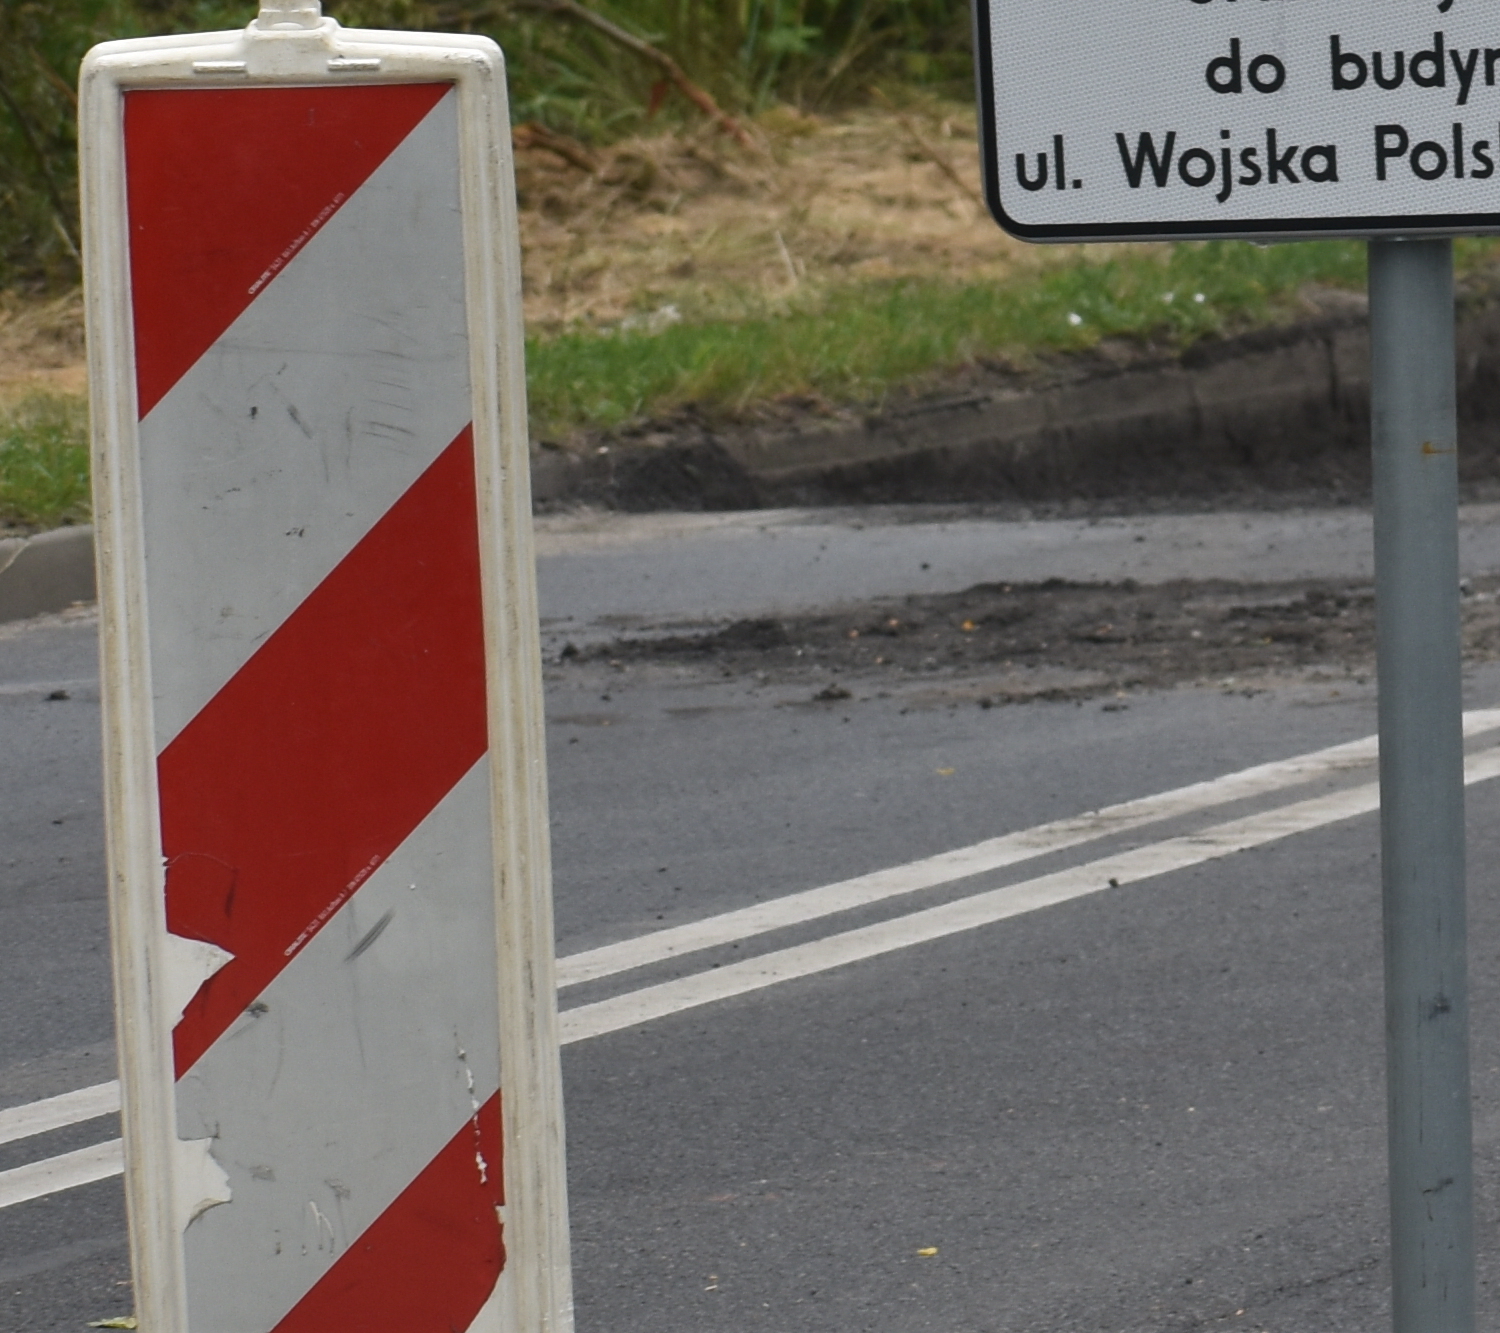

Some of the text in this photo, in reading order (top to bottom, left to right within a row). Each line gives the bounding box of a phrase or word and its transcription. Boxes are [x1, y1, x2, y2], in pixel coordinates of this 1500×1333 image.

[1204, 37, 1287, 95] do
[1015, 134, 1083, 192] ul.
[1114, 127, 1340, 204] Wojska
